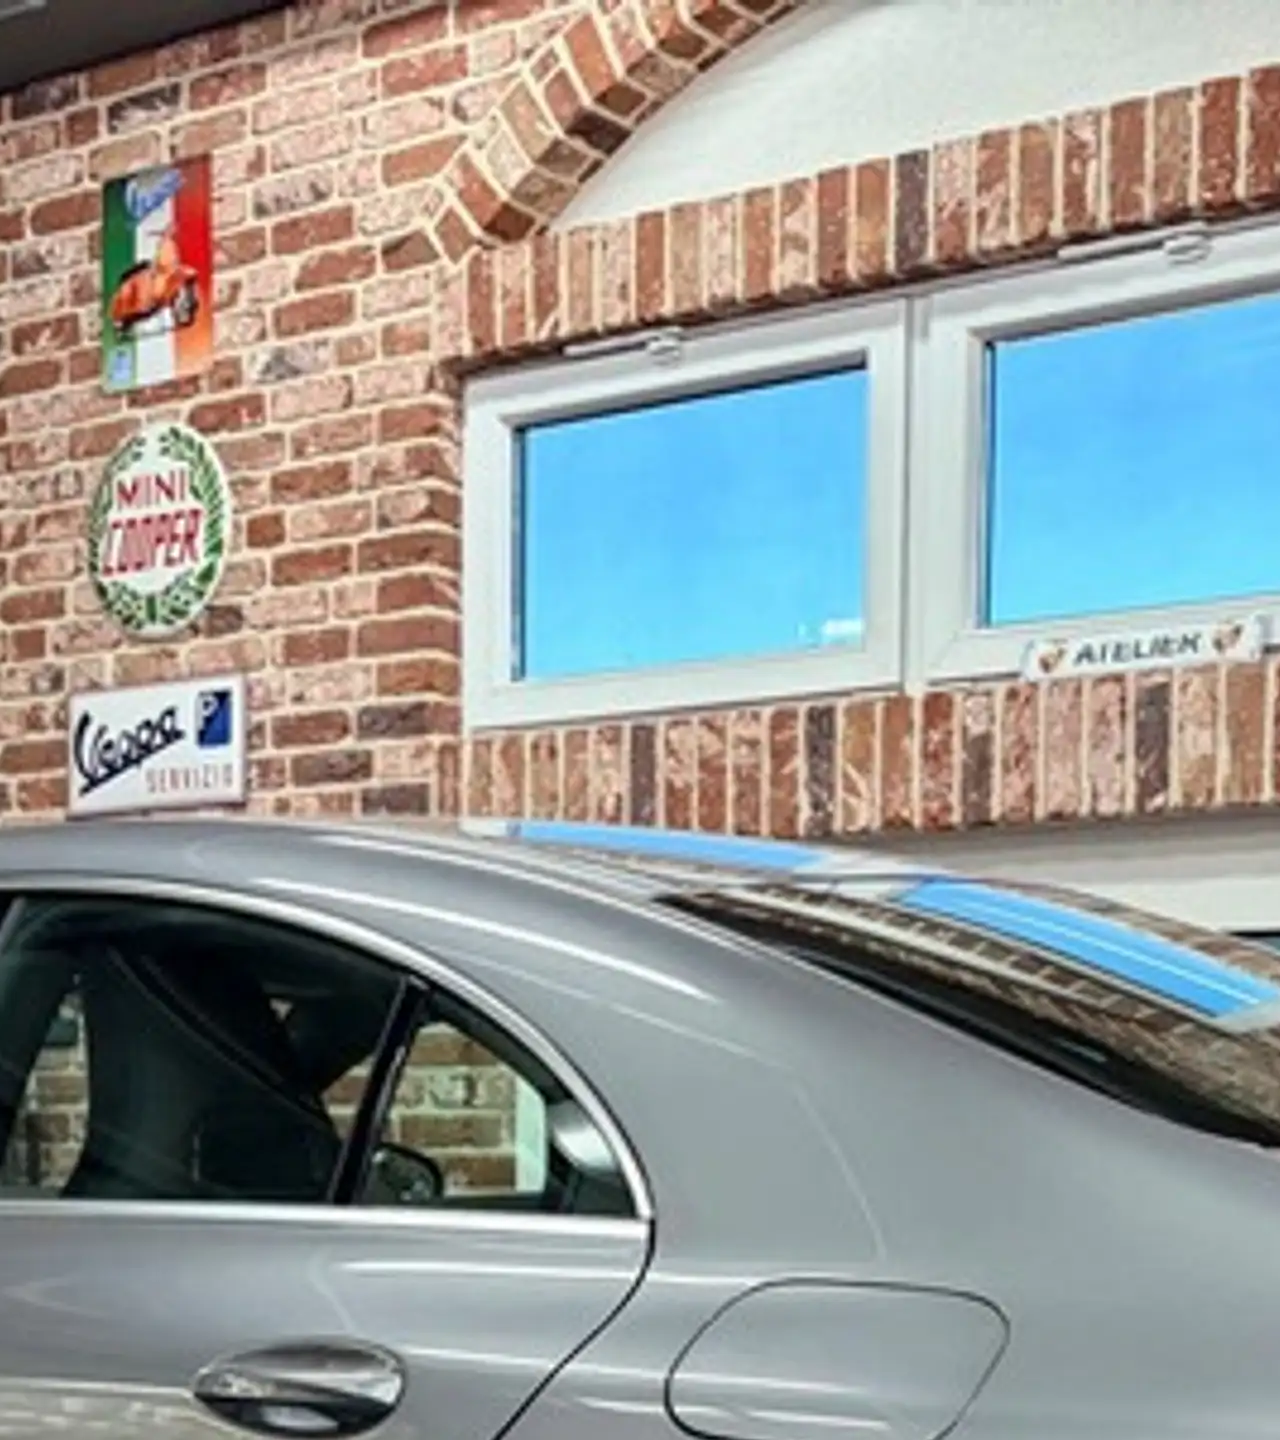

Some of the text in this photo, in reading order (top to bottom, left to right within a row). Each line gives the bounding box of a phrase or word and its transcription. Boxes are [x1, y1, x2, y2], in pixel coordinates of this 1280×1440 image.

[117, 468, 187, 512] MINI
[102, 508, 201, 577] COOPER
[74, 710, 186, 796] Vespa
